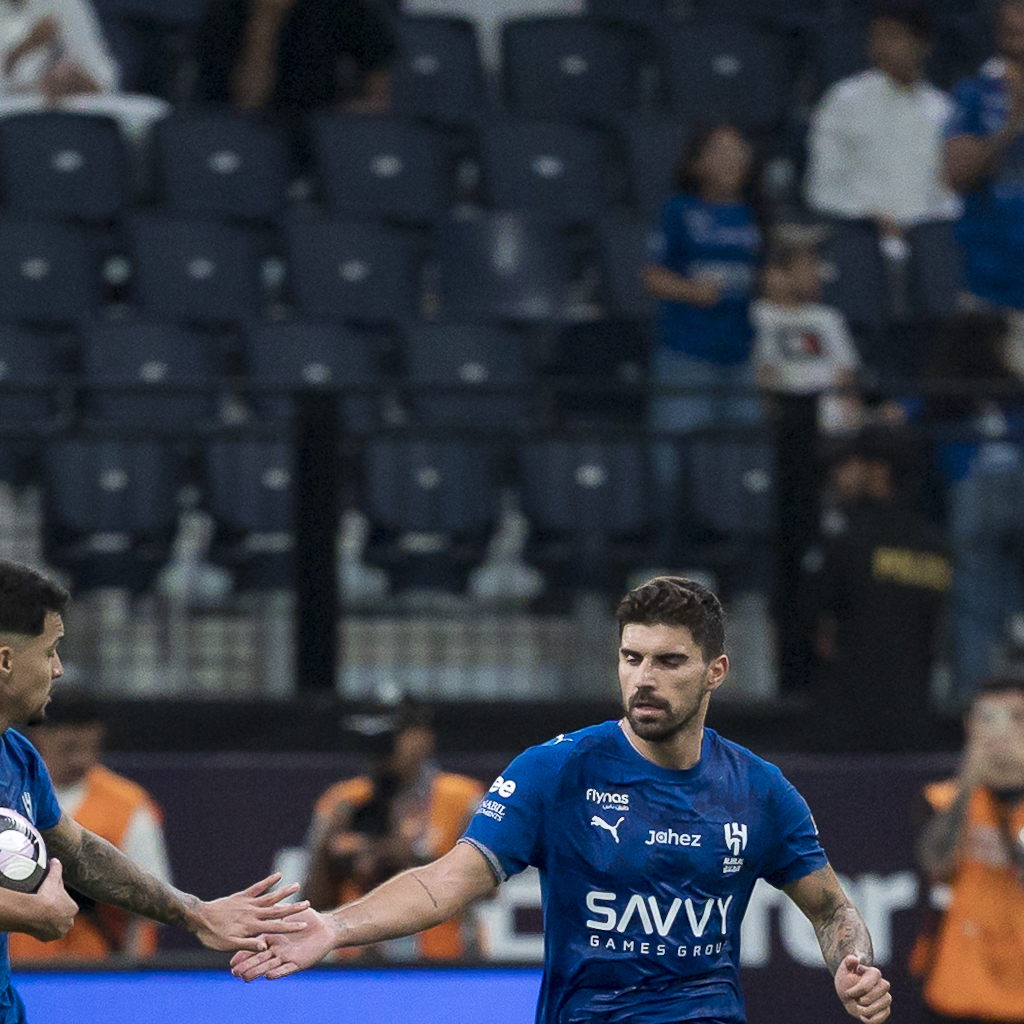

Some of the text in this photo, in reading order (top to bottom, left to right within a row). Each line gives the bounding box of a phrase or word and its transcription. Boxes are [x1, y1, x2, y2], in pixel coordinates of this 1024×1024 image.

[586, 788, 629, 805] flynas
[586, 890, 733, 938] SAVVY
[589, 934, 724, 957] GAMES GROU
